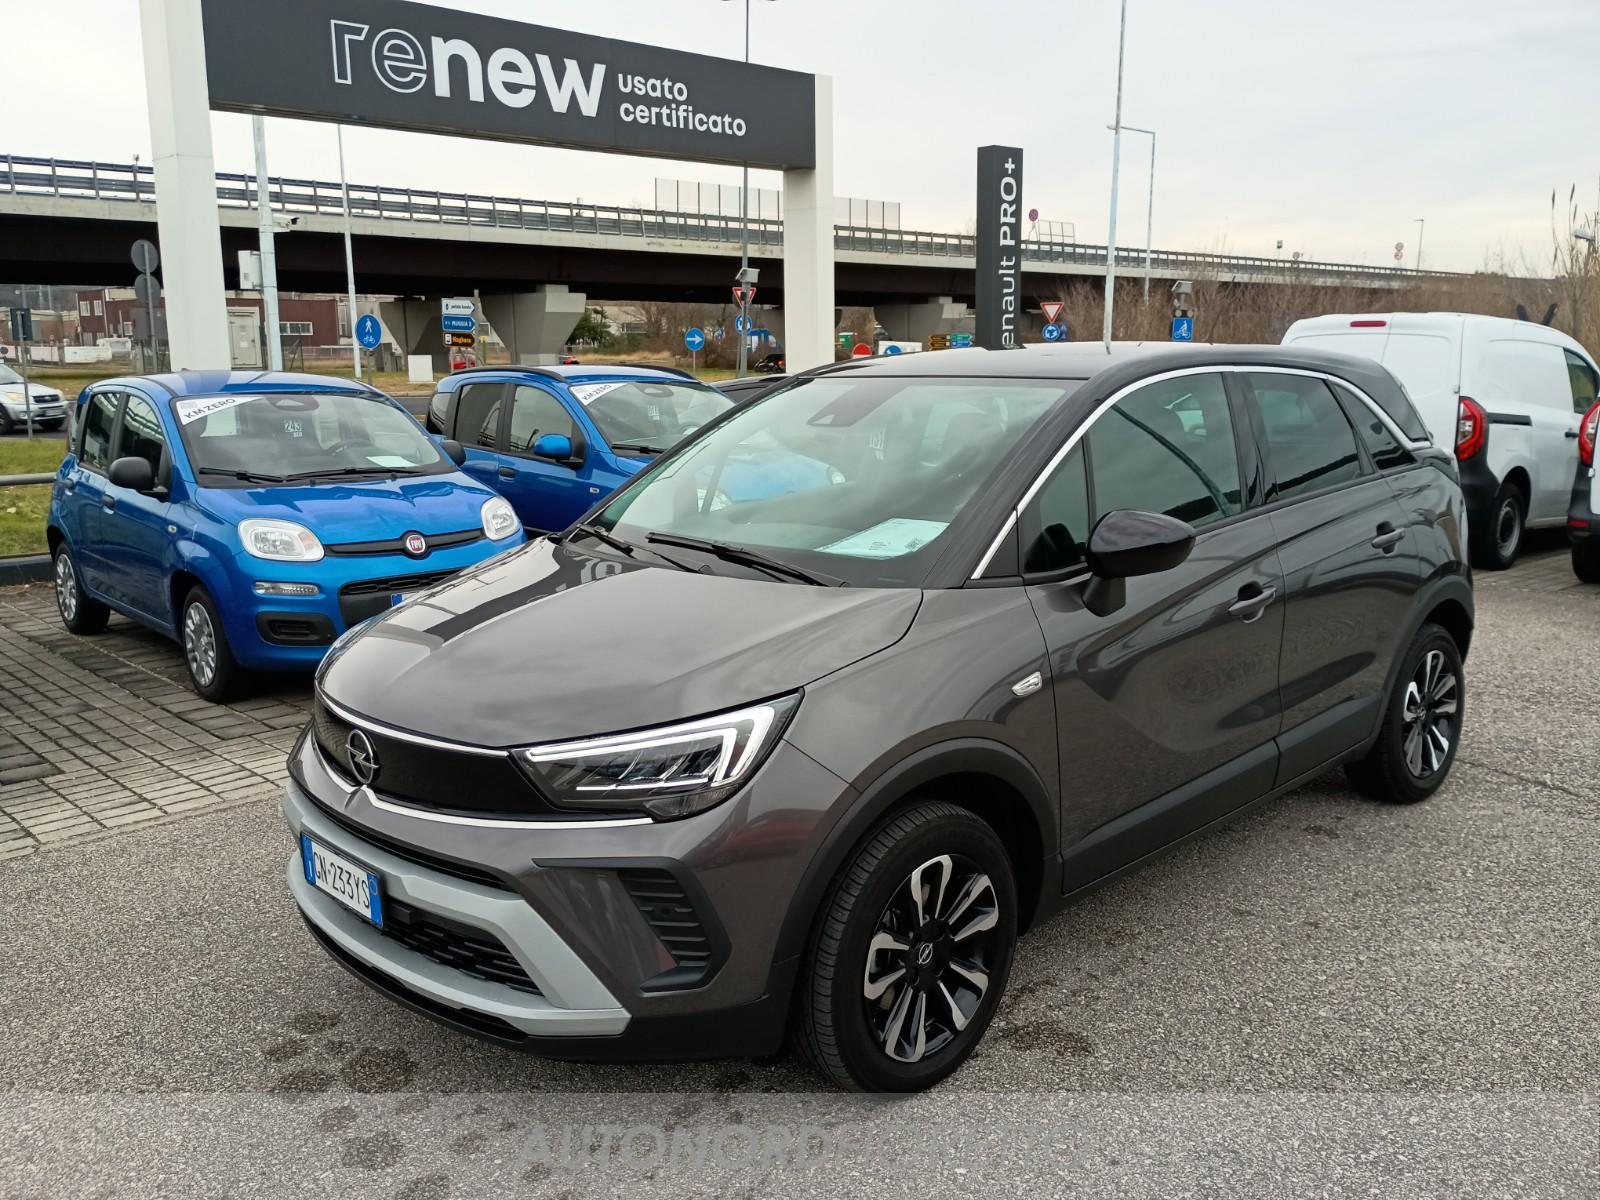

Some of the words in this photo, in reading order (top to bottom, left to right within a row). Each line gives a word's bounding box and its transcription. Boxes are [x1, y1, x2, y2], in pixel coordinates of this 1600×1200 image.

[330, 19, 606, 117] renew
[618, 73, 688, 101] usato
[620, 103, 747, 137] certificato
[1000, 158, 1017, 246] PRO+
[999, 255, 1015, 346] enault
[184, 408, 206, 419] KM
[206, 398, 236, 411] ZERO
